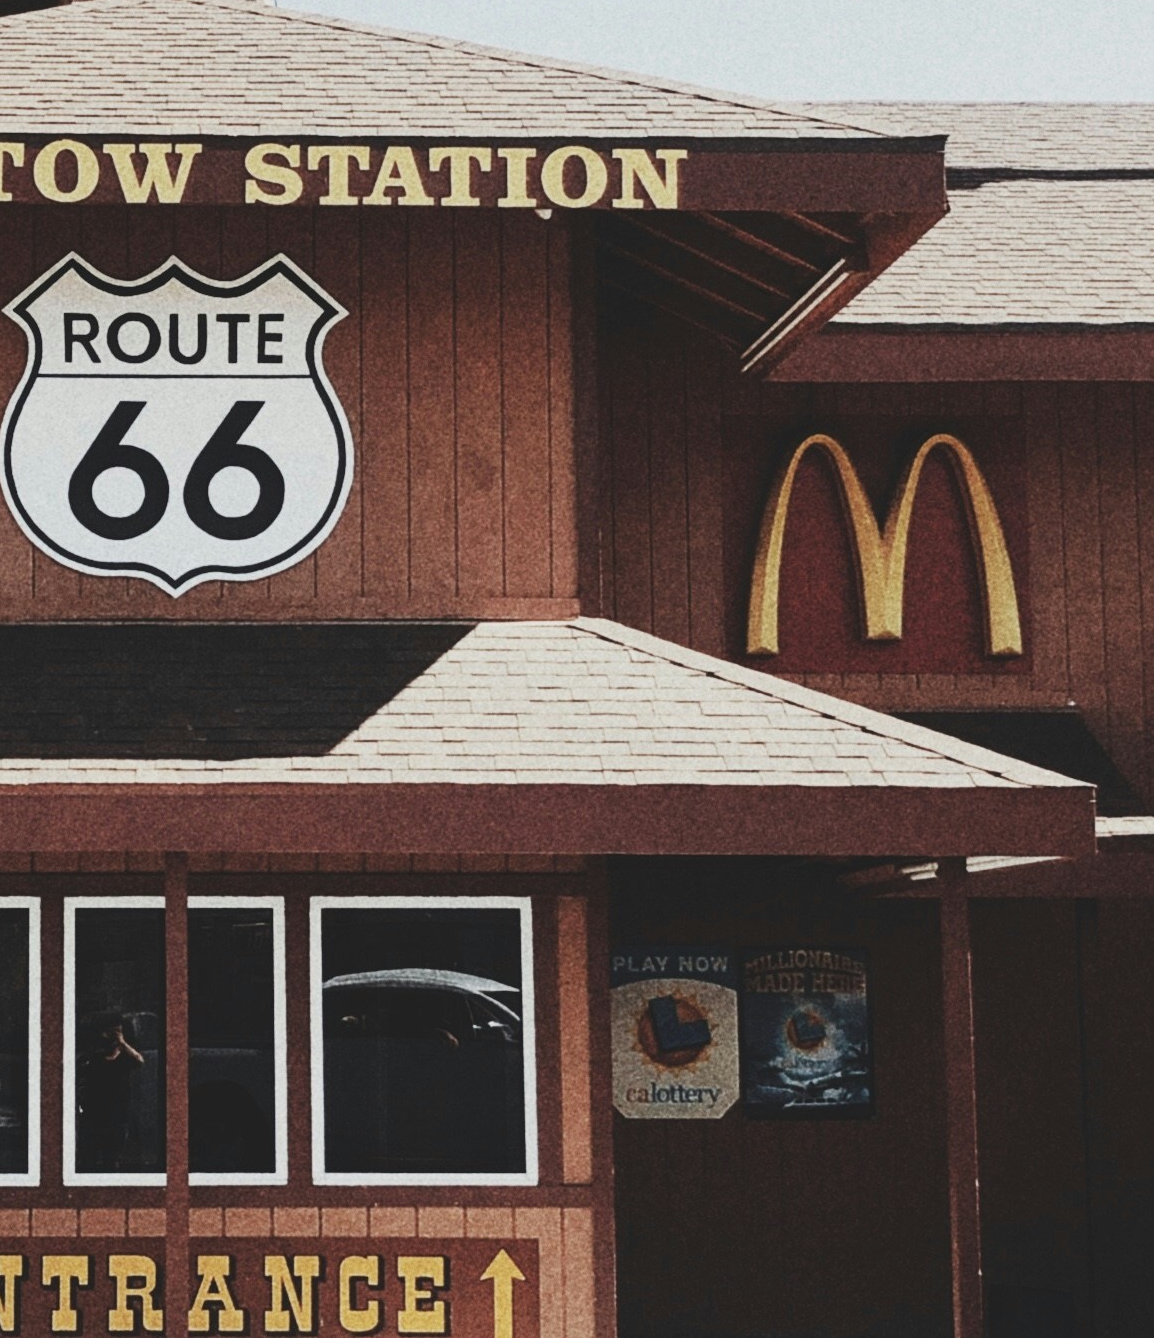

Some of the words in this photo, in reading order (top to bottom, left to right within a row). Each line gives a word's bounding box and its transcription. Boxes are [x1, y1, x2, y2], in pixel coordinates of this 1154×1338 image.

[245, 144, 688, 210] STATION
[64, 311, 286, 365] ROUTE
[67, 400, 286, 540] 66
[612, 956, 668, 972] PLAY
[679, 956, 729, 972] NOW
[745, 973, 805, 993] MADE
[626, 1082, 721, 1108] calottery
